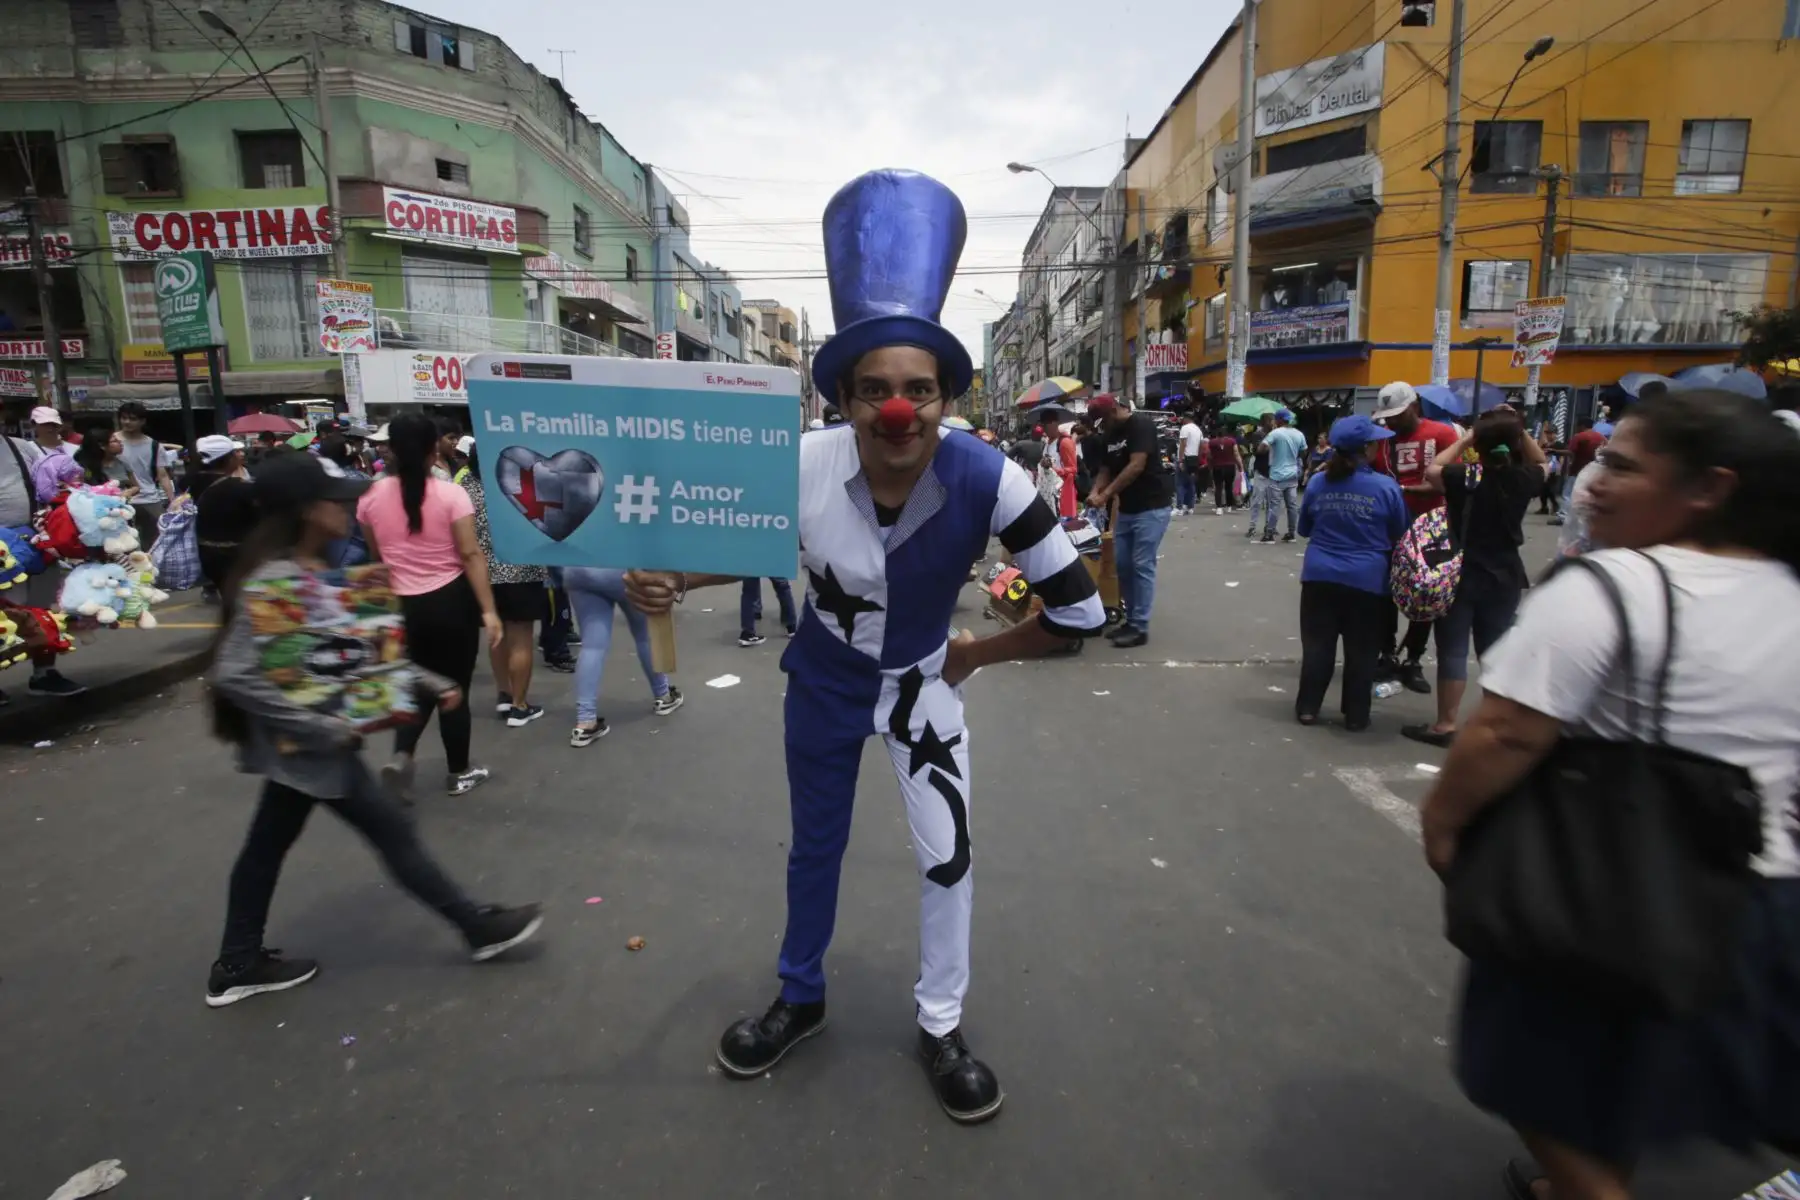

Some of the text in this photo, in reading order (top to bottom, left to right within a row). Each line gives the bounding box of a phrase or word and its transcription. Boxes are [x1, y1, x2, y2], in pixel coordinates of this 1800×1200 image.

[1318, 84, 1369, 113] Dental
[452, 201, 473, 211] PISO
[134, 206, 333, 251] CORTINAS
[386, 200, 516, 243] CORTINAS
[239, 248, 246, 257] DE
[248, 247, 279, 257] MUEBLES
[287, 245, 309, 255] FORRO
[311, 245, 319, 254] DE
[1516, 302, 1529, 315] 15
[484, 410, 789, 447] La Familia MIDIS tiene un
[670, 480, 744, 503] Amor
[671, 505, 790, 530] DeHierro
